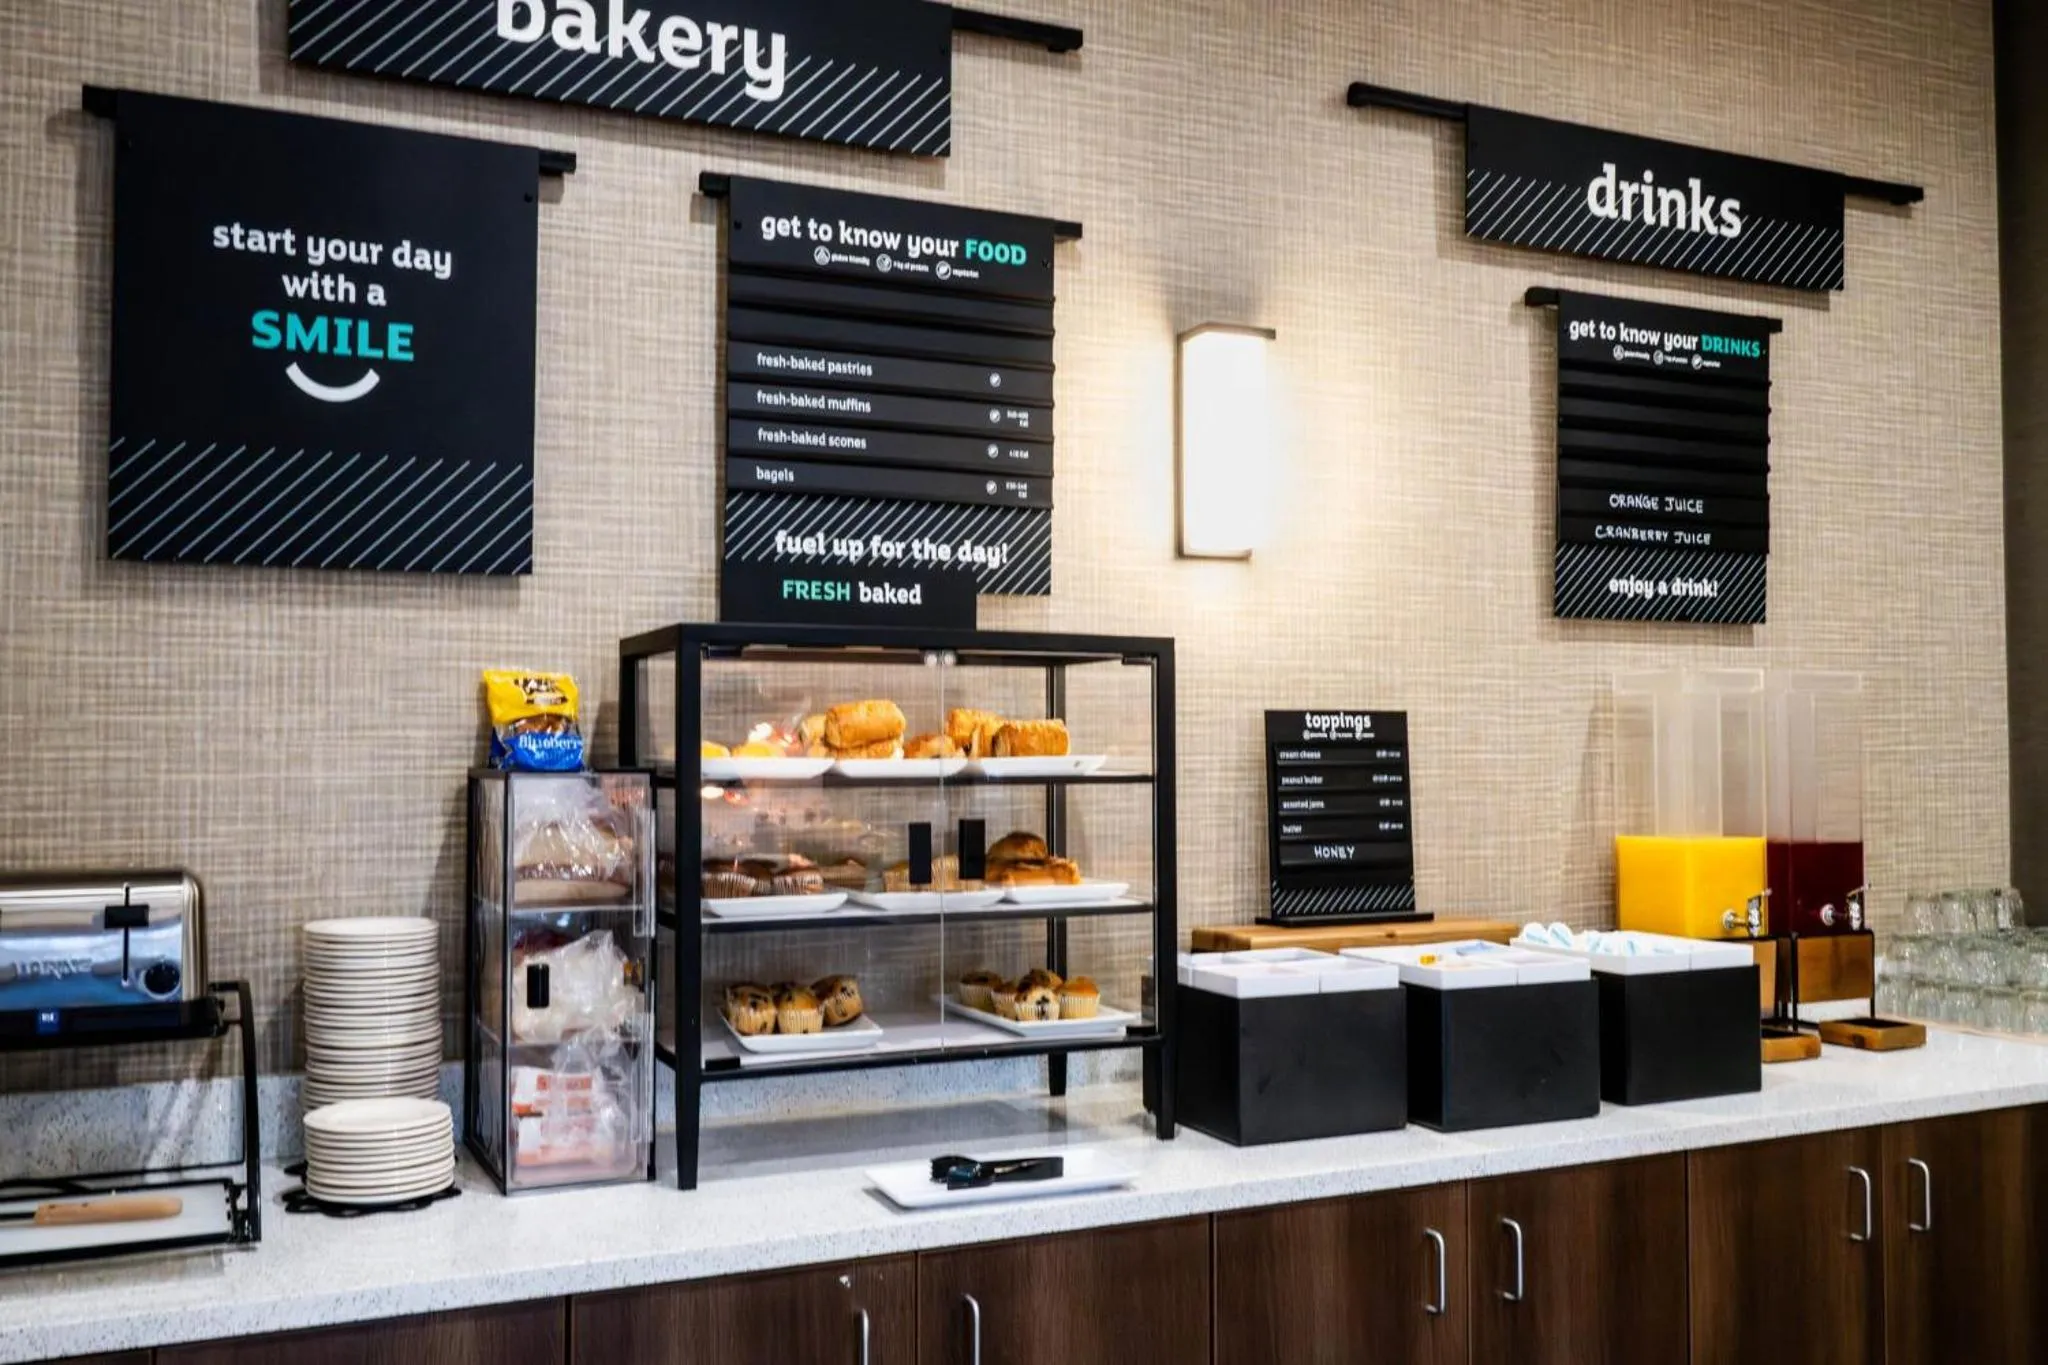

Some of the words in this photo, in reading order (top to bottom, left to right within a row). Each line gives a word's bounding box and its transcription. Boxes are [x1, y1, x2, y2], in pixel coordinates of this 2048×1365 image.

[1587, 162, 1742, 238] drinks
[212, 221, 297, 257] start
[306, 235, 383, 267] your
[392, 240, 453, 280] day
[761, 215, 802, 241] get
[807, 217, 833, 242] to
[838, 220, 901, 251] know
[907, 234, 960, 259] your
[964, 238, 1027, 266] FOOD
[281, 271, 356, 304] with
[366, 283, 387, 306] a
[251, 310, 415, 362] SMILE
[1569, 320, 1596, 340] get
[1599, 321, 1616, 340] to
[1619, 322, 1661, 346] know
[1664, 332, 1698, 351] your
[1702, 336, 1760, 357] DRINKS
[756, 352, 825, 373] fresh-baked
[828, 359, 873, 377] pastries
[756, 390, 825, 409] fresh-baked
[828, 397, 872, 413] muffins
[757, 427, 826, 447] fresh-baked
[828, 435, 867, 450] scones
[756, 465, 795, 483] bagels
[1608, 493, 1660, 512] ORANGE
[1664, 496, 1704, 514] JUICE
[1595, 524, 1669, 543] CRANBERRY
[1674, 530, 1712, 546] JUICE
[775, 529, 826, 556] fuel
[833, 536, 864, 563] up
[870, 534, 907, 559] for
[911, 536, 952, 562] the
[957, 539, 1008, 570] day!
[782, 579, 851, 601] FRESH
[858, 581, 922, 605] baked
[1608, 575, 1654, 598] enjoy
[1657, 581, 1668, 595] a
[1671, 577, 1718, 597] drink!
[1305, 711, 1371, 731] toppings
[1314, 845, 1355, 859] HONEY
